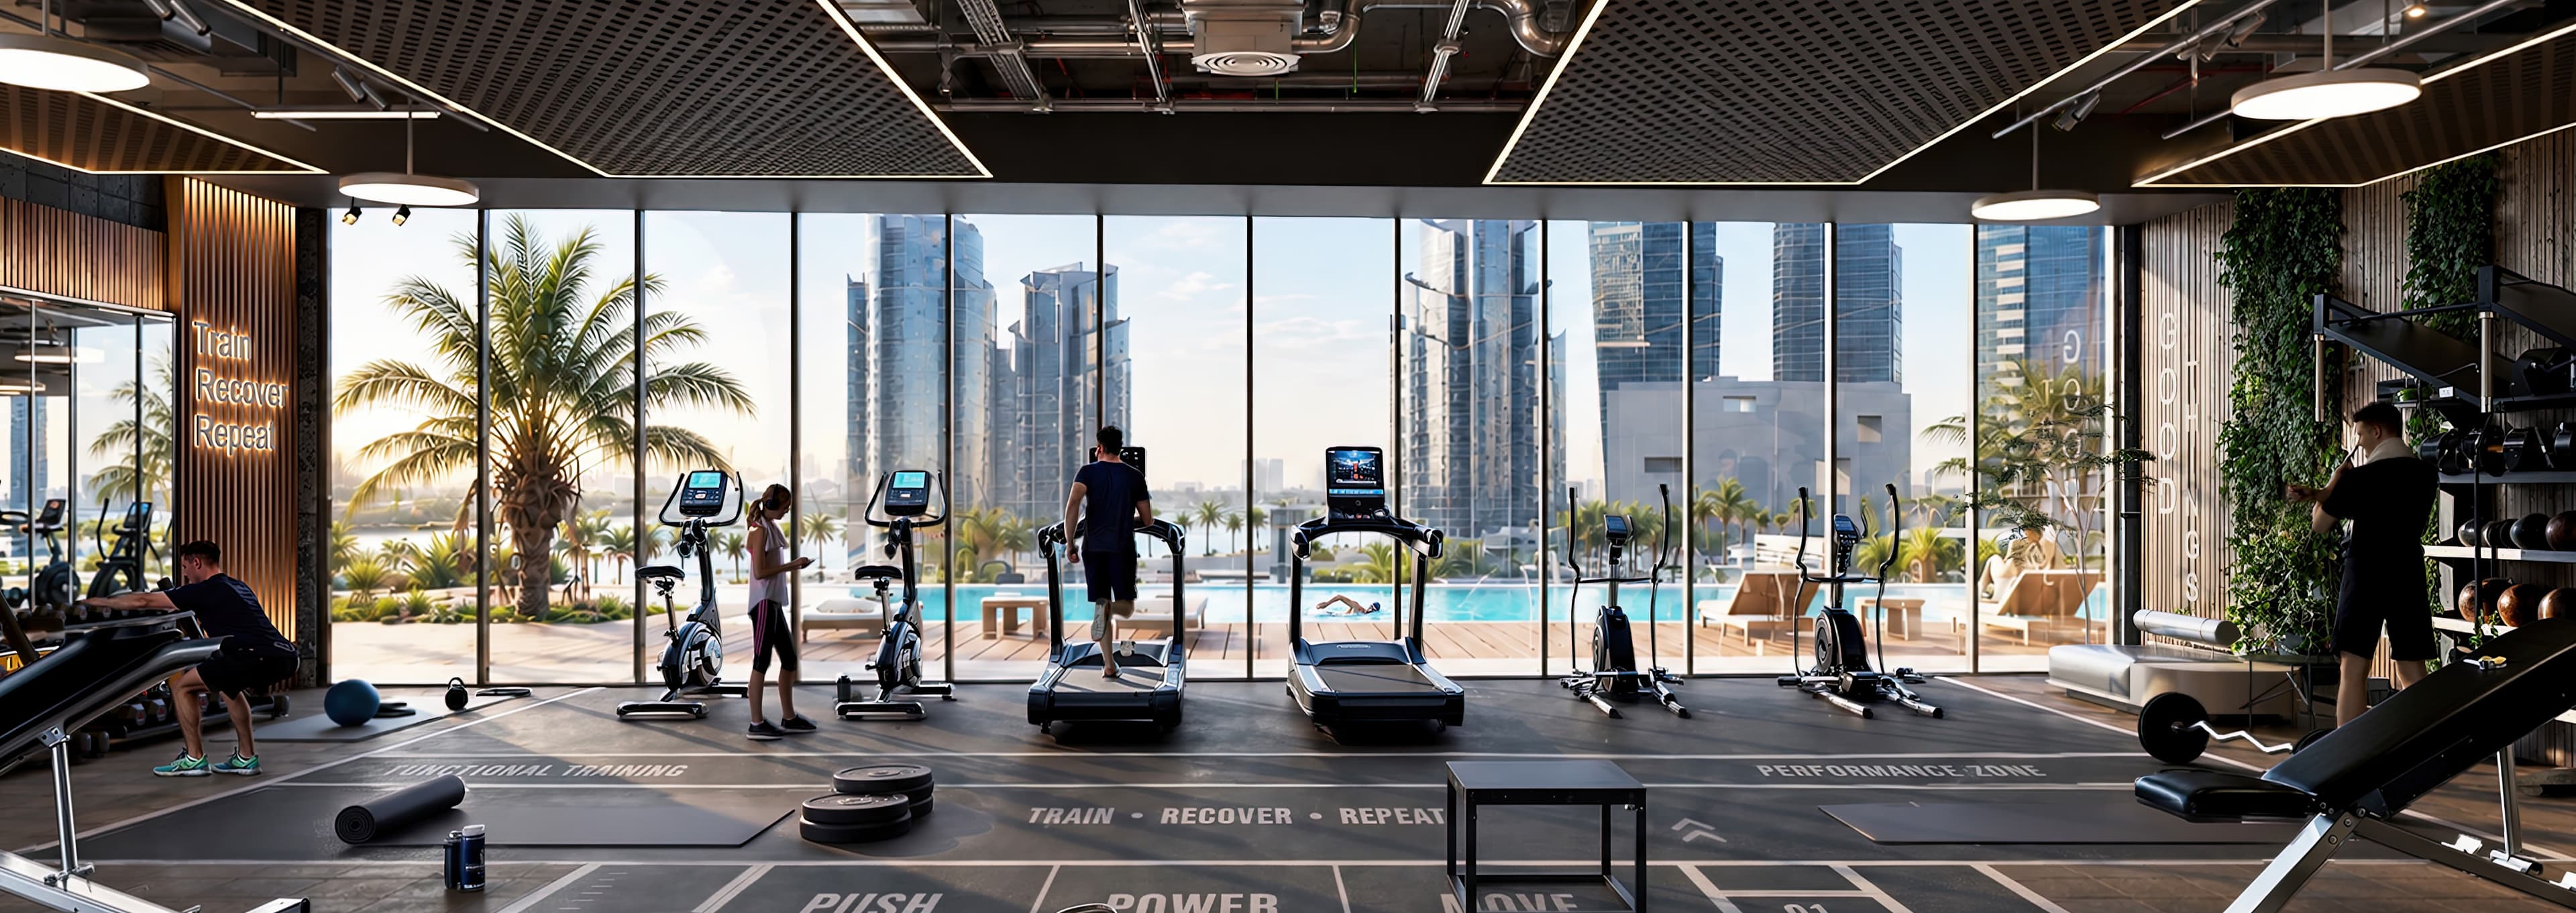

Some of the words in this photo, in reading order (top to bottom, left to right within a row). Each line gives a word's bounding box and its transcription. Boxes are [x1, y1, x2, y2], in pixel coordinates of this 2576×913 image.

[192, 321, 252, 361] Train
[195, 366, 289, 409] Recover
[2159, 312, 2178, 515] GOOD
[194, 413, 276, 457] Repeat
[561, 764, 689, 777] TRAINING
[1755, 764, 1965, 777] PERFORMANCE
[1964, 764, 2047, 777] ZONE
[1028, 807, 1115, 825] TRAIN
[1161, 807, 1293, 825] RECOVER
[1339, 807, 1444, 825] REPEAT
[799, 892, 944, 913] PUSH
